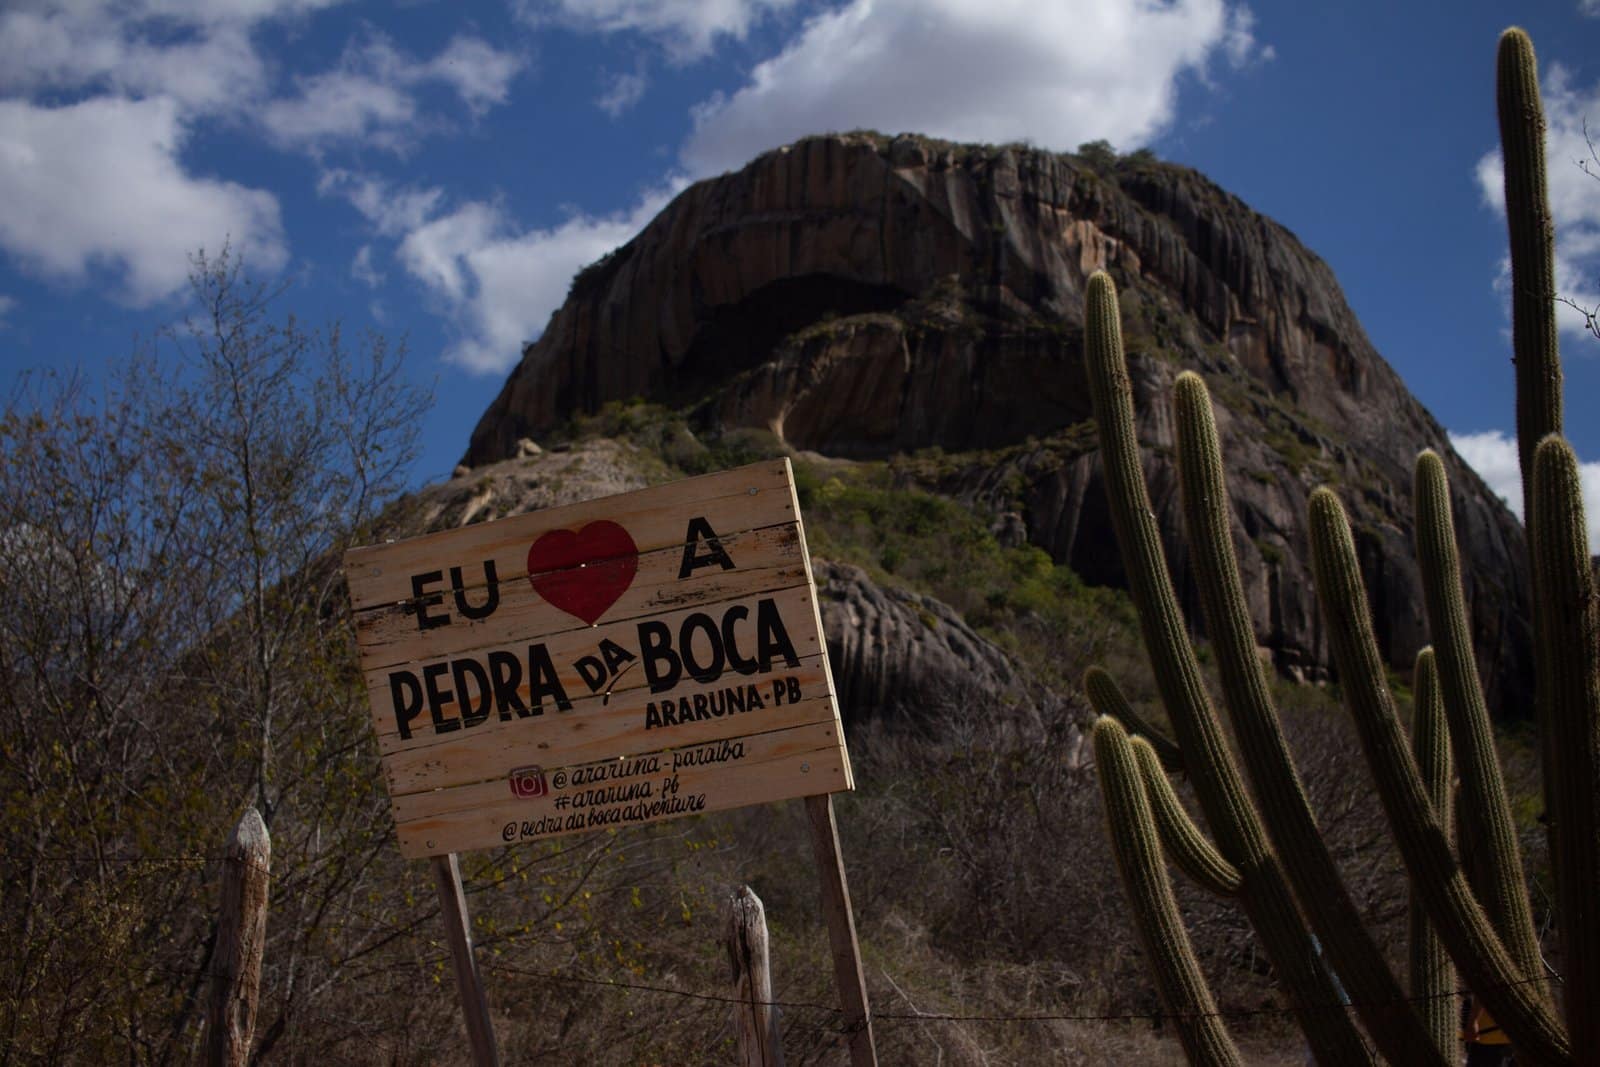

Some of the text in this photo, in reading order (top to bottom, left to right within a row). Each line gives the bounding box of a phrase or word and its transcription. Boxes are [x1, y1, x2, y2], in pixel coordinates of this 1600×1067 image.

[411, 516, 736, 631] EU A
[389, 598, 801, 740] PEDRA DA BOCA
